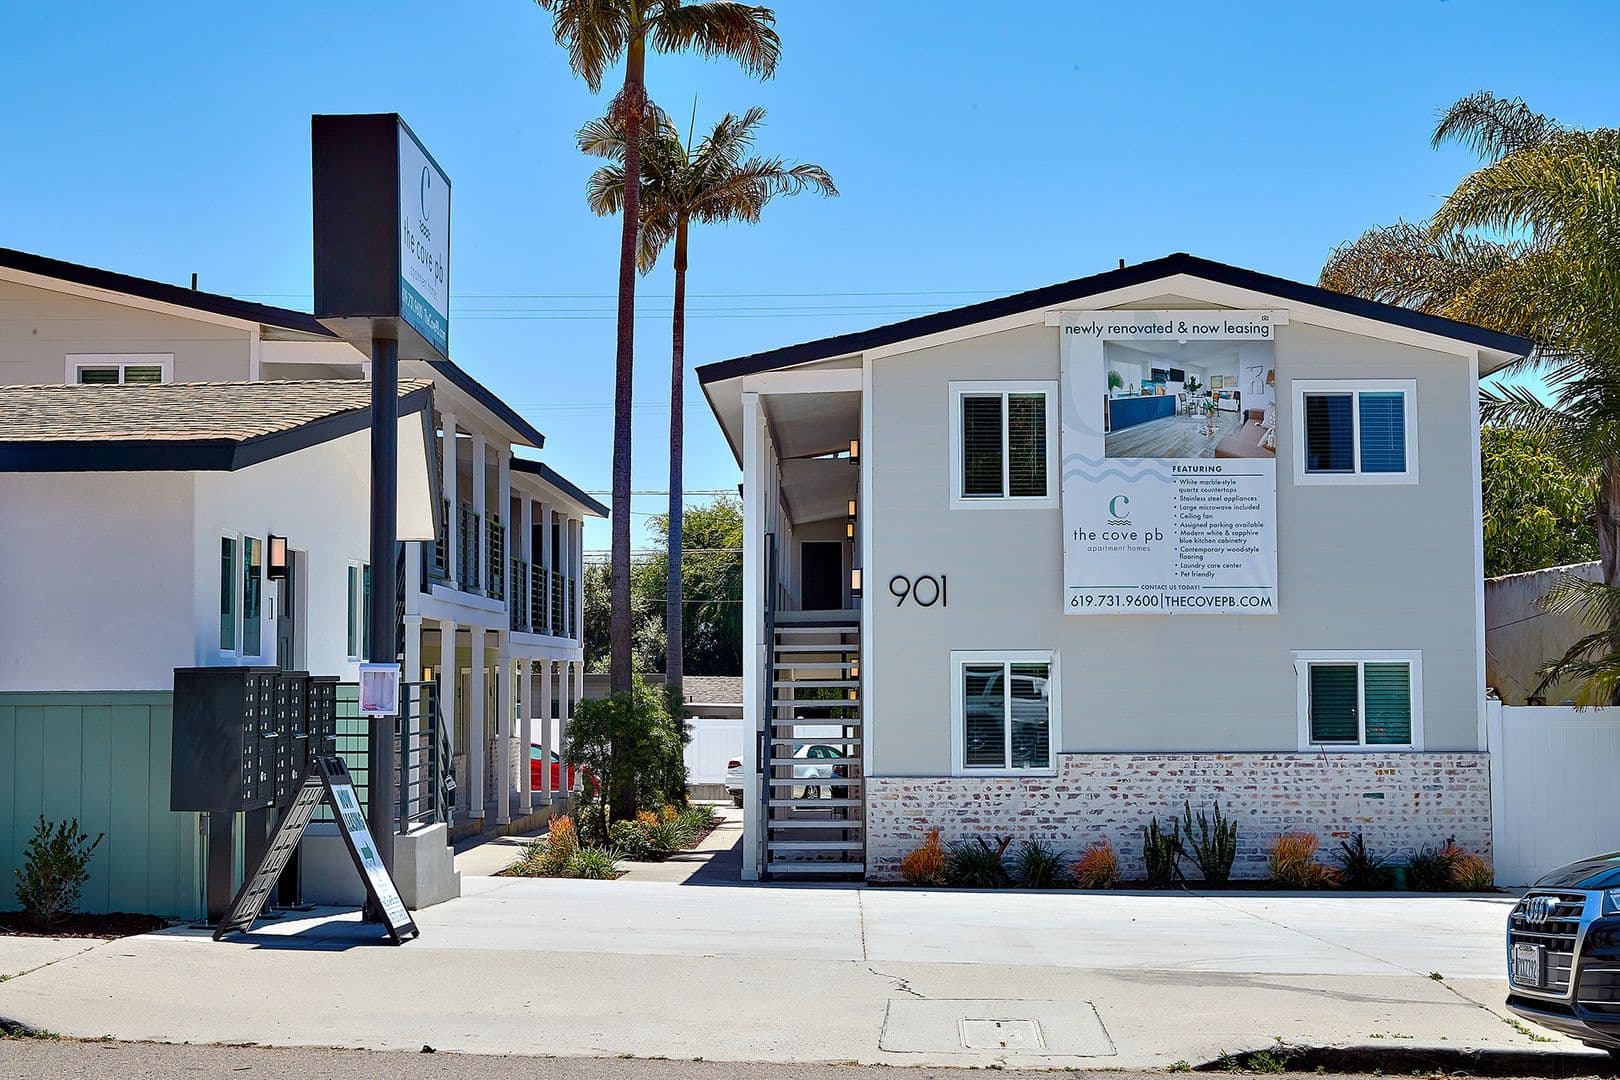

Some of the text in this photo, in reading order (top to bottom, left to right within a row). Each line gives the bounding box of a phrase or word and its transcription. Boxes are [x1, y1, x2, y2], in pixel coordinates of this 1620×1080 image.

[403, 215, 444, 286] the cove pb
[1065, 320, 1269, 338] newly renovated & now leasing
[1223, 495, 1258, 503] appliances
[1180, 512, 1202, 520] Ceiling
[1180, 521, 1208, 529] Assigned
[1209, 521, 1234, 529] parking
[1073, 527, 1164, 545] the cove pb
[1231, 529, 1259, 537] sapphire
[1217, 537, 1248, 545] cabinetry
[1180, 545, 1225, 554] Contemporary
[1179, 553, 1204, 561] flooring
[1180, 562, 1205, 570] Laundry
[1191, 570, 1216, 579] friendly
[889, 574, 947, 608] 901
[1070, 595, 1273, 607] 619.731.9600 THECOVEPB.COM
